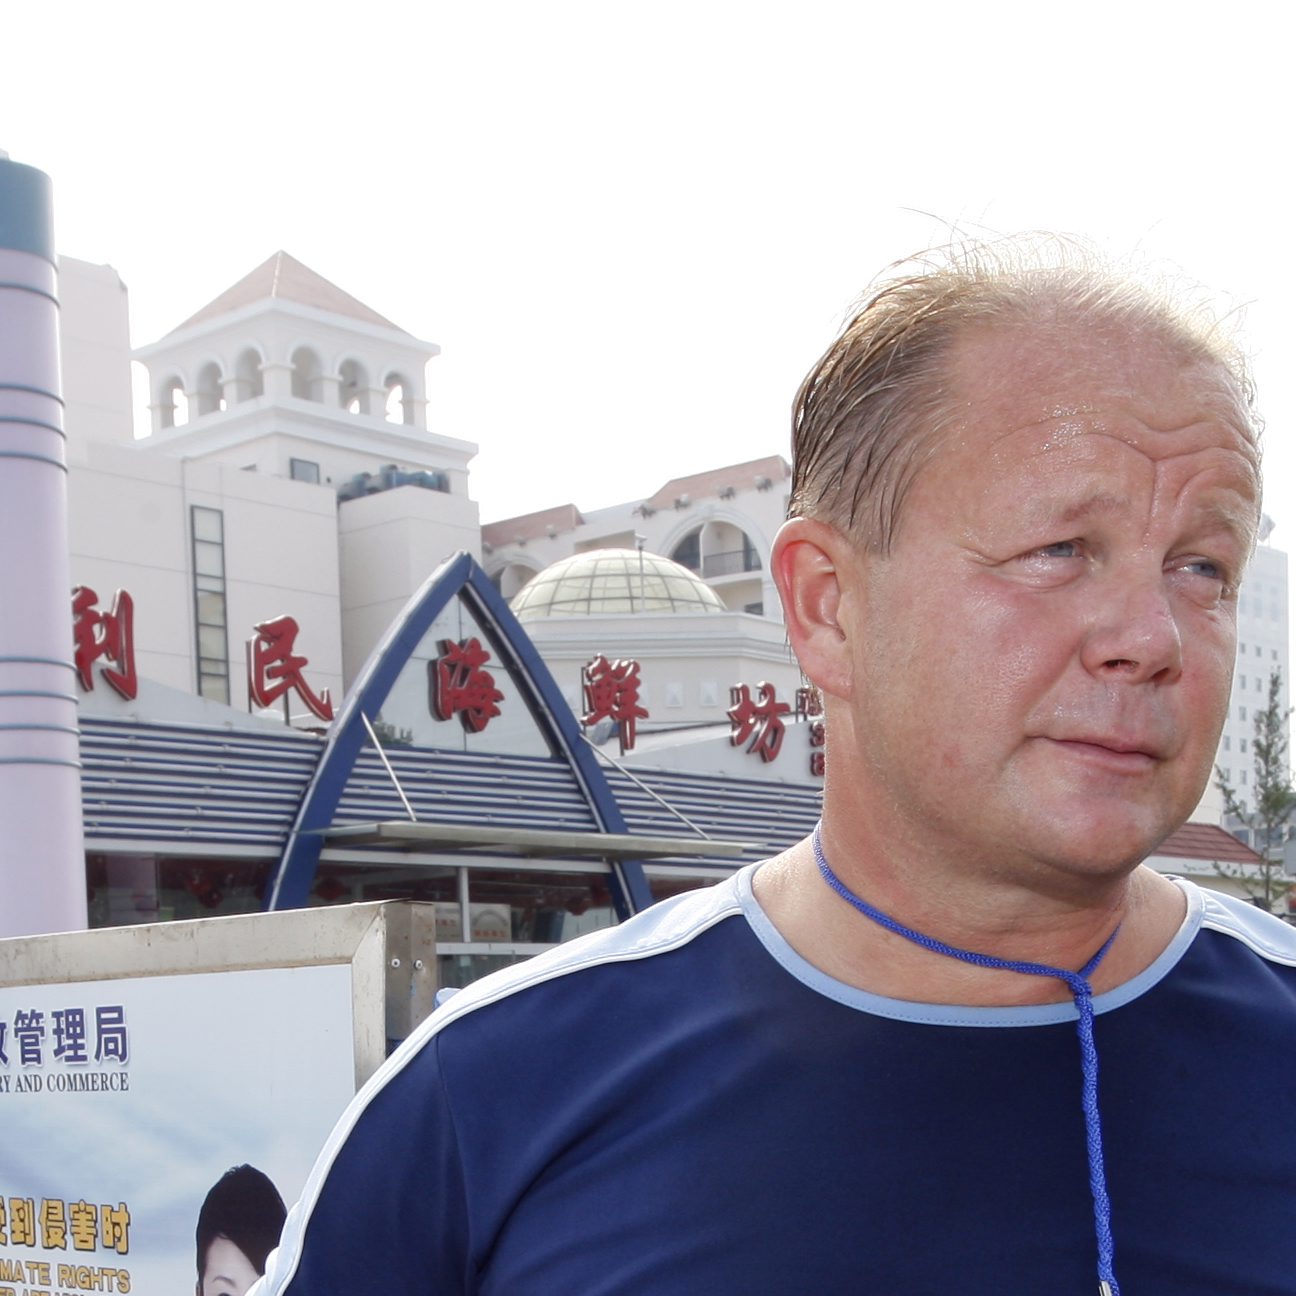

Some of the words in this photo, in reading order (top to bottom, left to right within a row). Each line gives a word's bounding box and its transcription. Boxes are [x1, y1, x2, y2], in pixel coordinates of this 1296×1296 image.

[71, 586, 791, 763] 利民海鲜坊
[15, 1074, 43, 1093] AND
[46, 1072, 130, 1092] COMMERCE
[57, 1263, 131, 1294] RIGHTS
